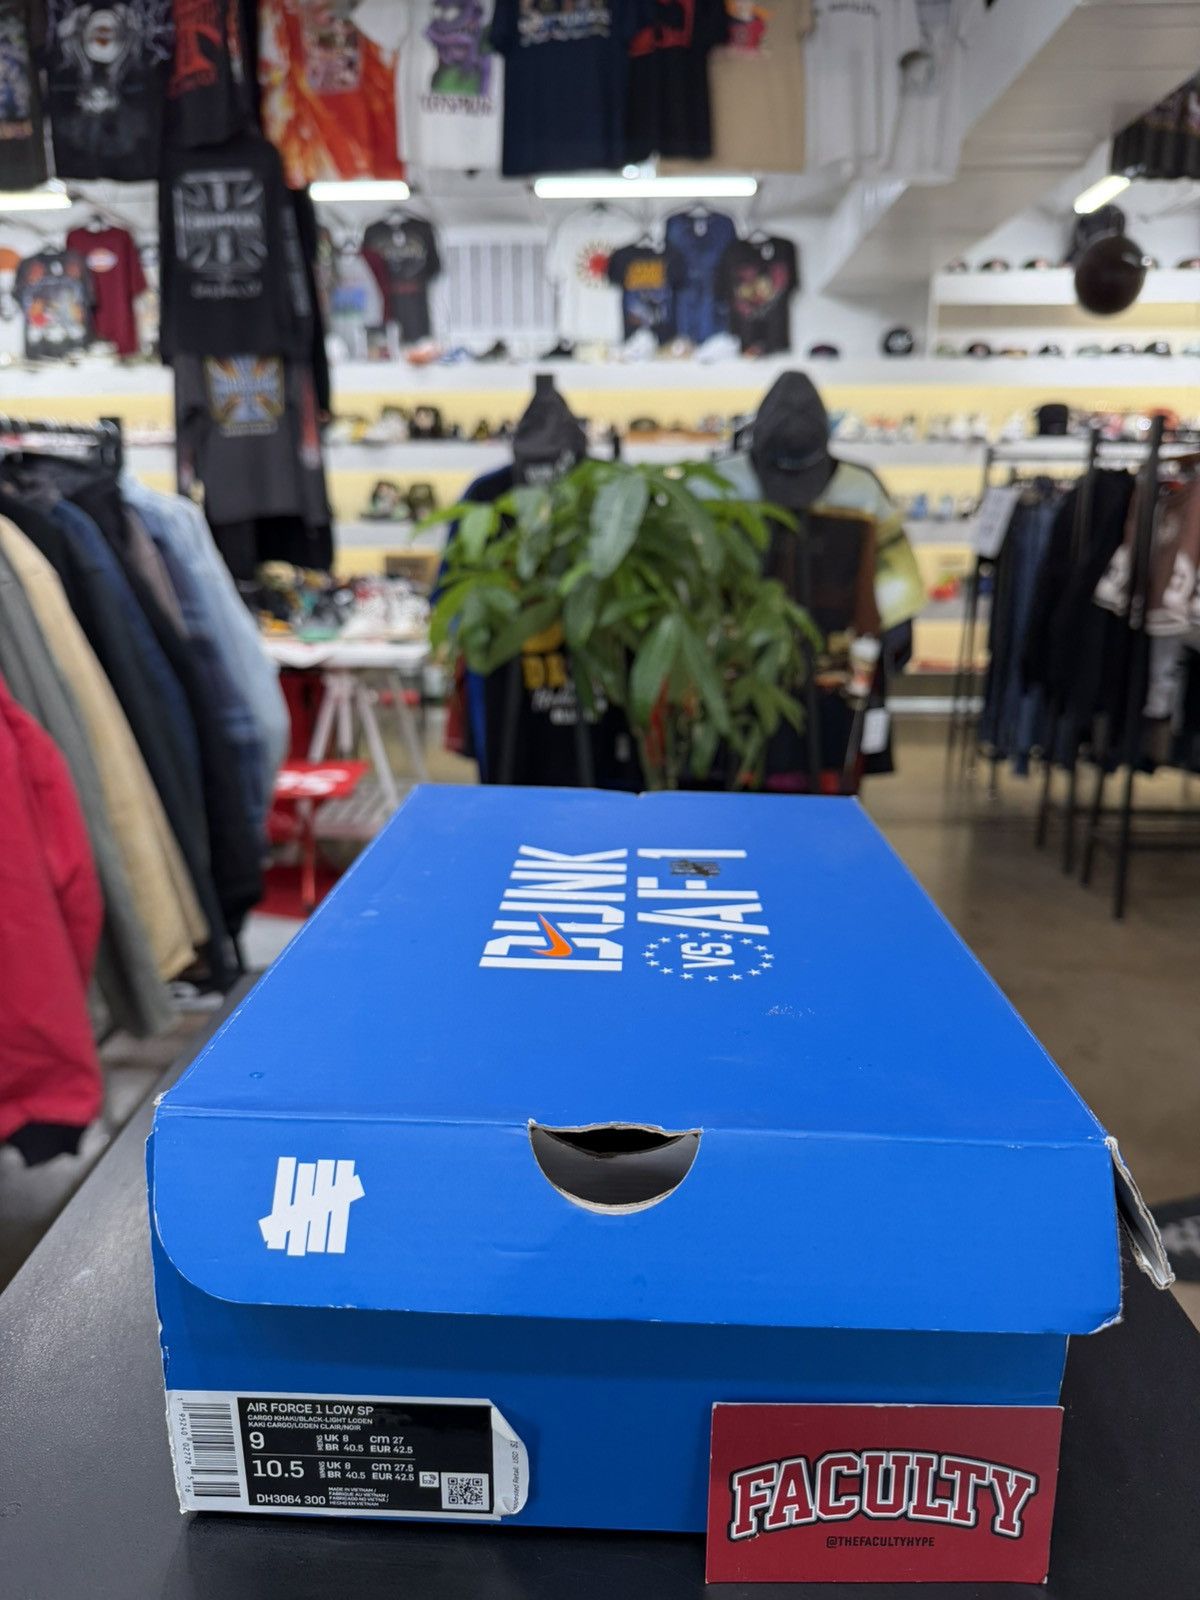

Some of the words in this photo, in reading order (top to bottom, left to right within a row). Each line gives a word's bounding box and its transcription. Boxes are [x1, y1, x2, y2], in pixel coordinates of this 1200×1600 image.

[479, 845, 628, 971] DUNK
[681, 942, 735, 969] VS
[247, 1402, 268, 1412] AIR
[270, 1403, 312, 1414] FORCE
[316, 1404, 324, 1414] 1
[326, 1405, 354, 1414] LOW
[358, 1406, 374, 1416] SP
[179, 1413, 188, 1435] 95240
[274, 1415, 346, 1423] KHAKI/BLACK-LIGHT
[250, 1432, 264, 1449] 9
[324, 1434, 339, 1442] UK
[370, 1435, 390, 1444] cm
[344, 1444, 364, 1452] 40.5
[370, 1445, 391, 1453] EUR
[393, 1446, 413, 1454] 42.5
[252, 1460, 304, 1477] 10.5
[345, 1462, 351, 1470] 8
[372, 1463, 391, 1471] cm
[394, 1464, 414, 1472] 27.5
[346, 1471, 366, 1479] 40.5
[372, 1472, 392, 1480] EUR
[256, 1494, 300, 1504] DH3064
[304, 1495, 326, 1505] 300
[730, 1450, 1038, 1541] FACULTY
[826, 1536, 935, 1548] @THEFACULTYHYPE
